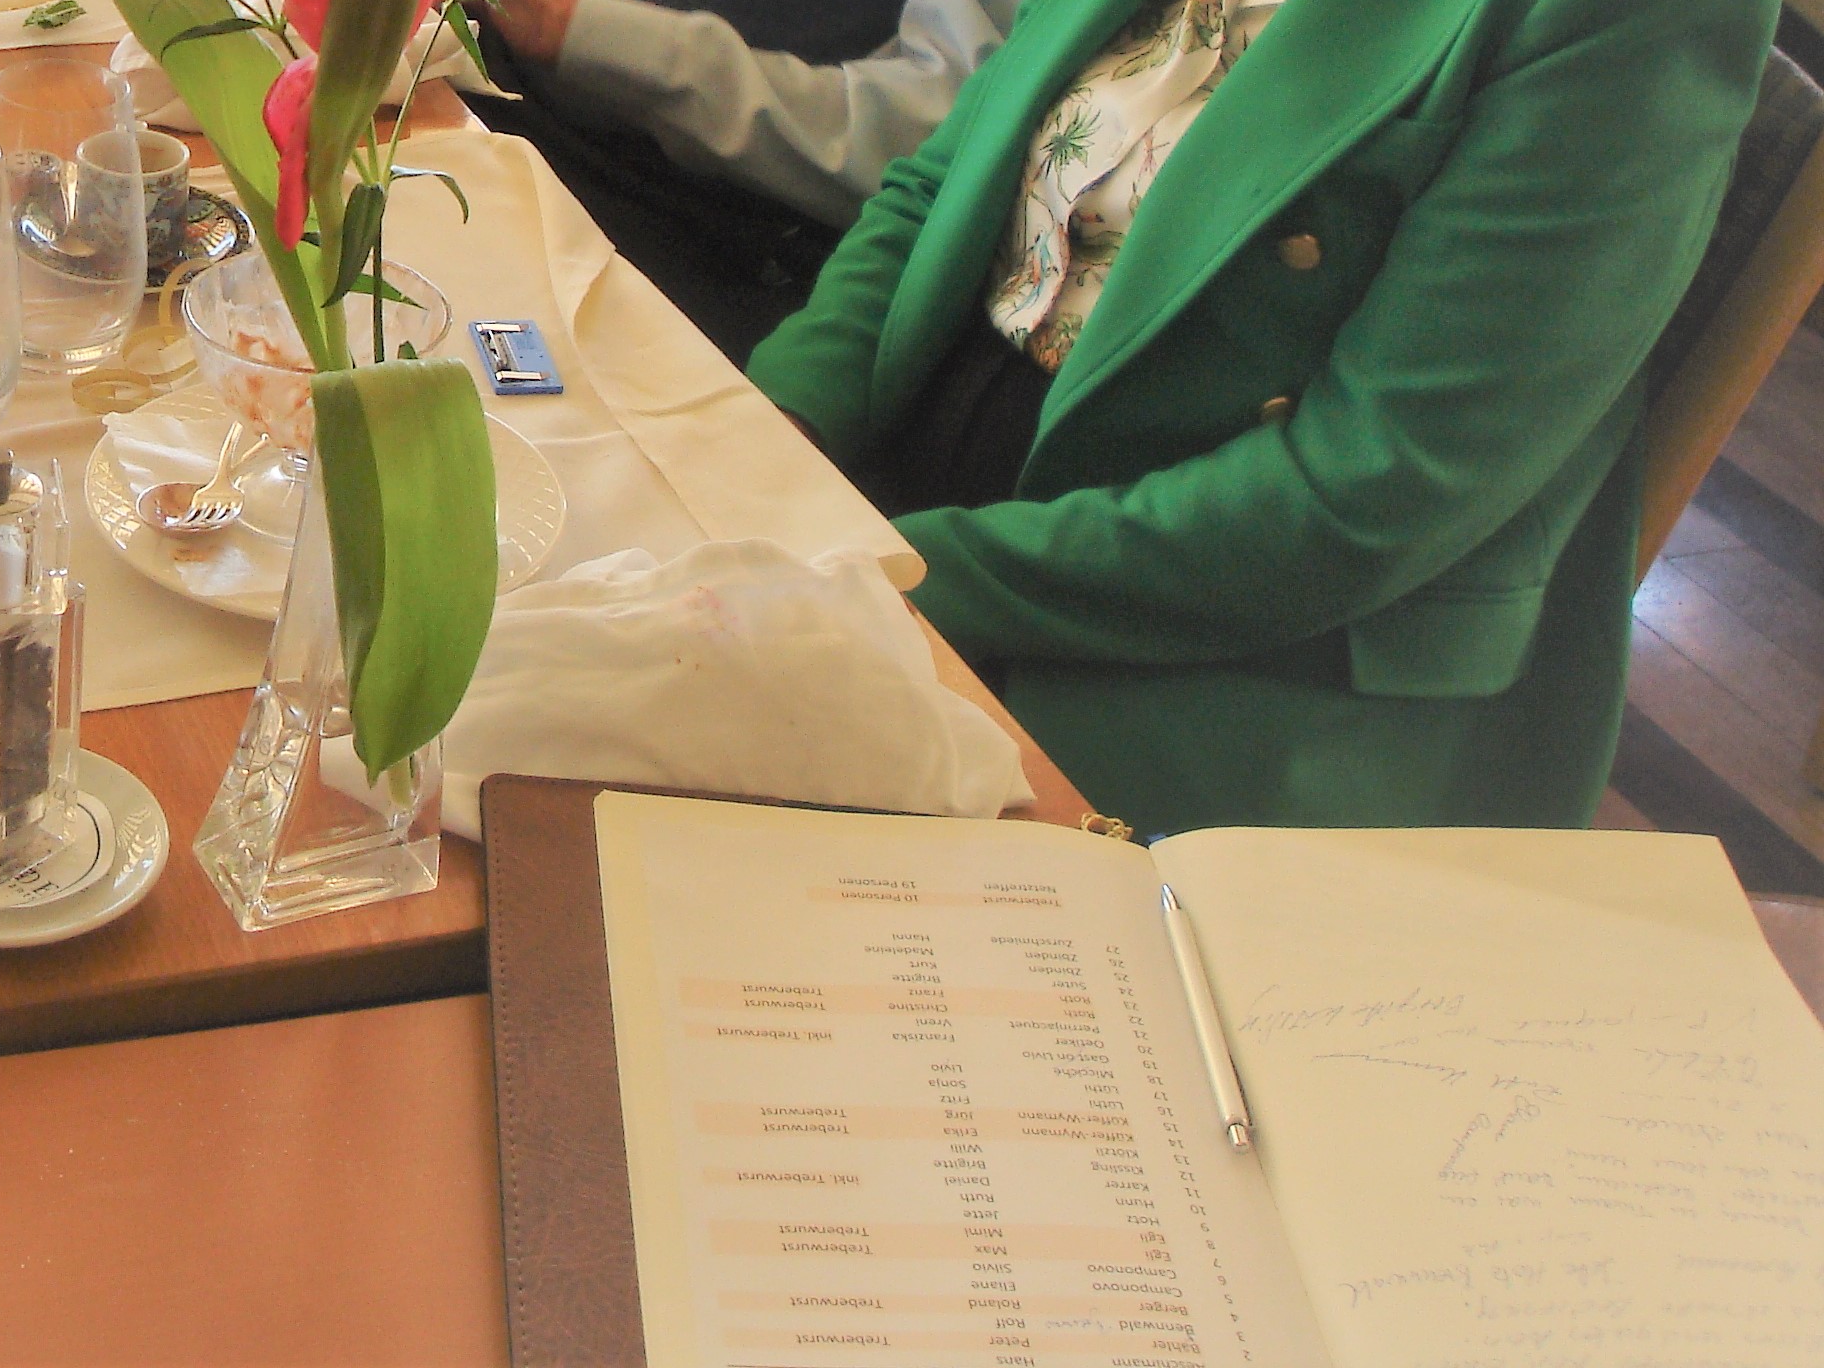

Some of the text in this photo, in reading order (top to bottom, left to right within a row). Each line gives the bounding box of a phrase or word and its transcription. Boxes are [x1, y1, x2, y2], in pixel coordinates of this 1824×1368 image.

[837, 876, 898, 889] Personen
[901, 879, 917, 890] 19
[840, 891, 1062, 908] Treberwurst 10 Personen
[891, 932, 930, 942] Hanni
[990, 935, 1073, 949] Zurschmiede
[863, 944, 934, 956] Madeleine
[1024, 950, 1078, 963] Zbinden
[909, 959, 937, 970] Kurt
[1028, 965, 1082, 977] Zbinden
[892, 972, 941, 984] Brigitte
[741, 983, 823, 997] Treberwurst
[1051, 979, 1087, 991] Suter
[908, 988, 945, 998] Franz
[743, 998, 826, 1011] Treberwurst
[1059, 994, 1091, 1005] Roth
[888, 1001, 948, 1013] Christine
[1063, 1008, 1096, 1020] Roth
[916, 1017, 952, 1027] Vreni
[1133, 1029, 1148, 1040] 21
[716, 1026, 1153, 1056] 20 Oetiker Franziska inkl. Treberwurst
[1022, 1050, 1053, 1062] Livio
[930, 1063, 963, 1074] Livio
[1142, 1059, 1158, 1071] 19
[928, 1077, 966, 1090] Sonja
[939, 1094, 971, 1106] Fritz
[1153, 1090, 1168, 1102] 17
[760, 1106, 847, 1119] Treberwurst
[1157, 1105, 1173, 1117] 16
[1163, 1121, 1178, 1133] 15
[762, 1122, 1184, 1149] 14 Küffer-Wymann Erika Treberwurst
[950, 1143, 982, 1154] Willi
[1174, 1154, 1189, 1166] 13
[932, 1157, 1195, 1181] 12 Kissling Brigitte
[736, 1171, 1200, 1198] 11 Karrer Daniel inkl. Treberwurst
[960, 1192, 1206, 1215] 10 Hunn Ruth
[963, 1209, 1209, 1232] 9 Hotz Jette
[779, 1224, 869, 1237] Treberwurst
[964, 1226, 1004, 1238] Mimi
[1140, 1231, 1166, 1245] Egli
[782, 1242, 1221, 1268] 7 Egli Max Treberwurst
[972, 1263, 1227, 1286] 6 Camponovo Silvio
[971, 1280, 1016, 1292] Eliane
[1092, 1282, 1183, 1298] Camponovo
[789, 1296, 883, 1309] Treberwurst
[968, 1298, 1021, 1310] Roland
[1139, 1301, 1188, 1317] Berger
[996, 1318, 1026, 1329] Rolf
[796, 1334, 890, 1347] Treberwurst
[990, 1336, 1030, 1348] Peter
[1236, 1331, 1245, 1342] 3
[995, 1355, 1035, 1368] Hans
[1243, 1350, 1252, 1361] 2
